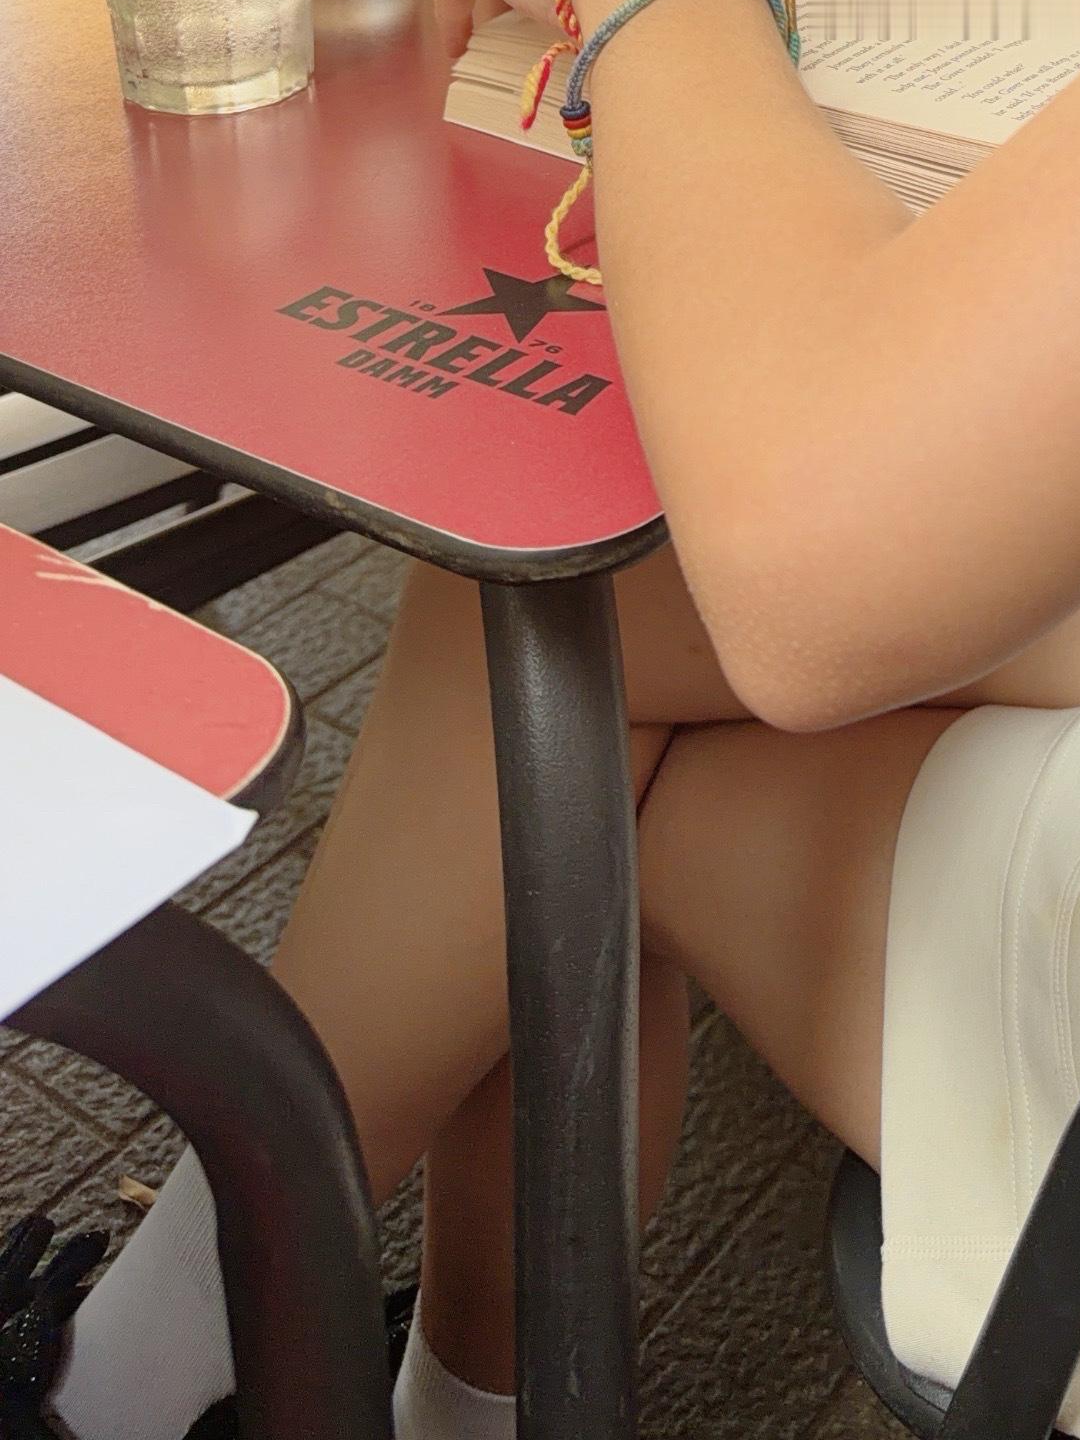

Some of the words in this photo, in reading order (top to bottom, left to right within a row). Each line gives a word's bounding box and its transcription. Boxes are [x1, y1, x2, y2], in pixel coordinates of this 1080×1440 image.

[409, 300, 437, 311] 18
[275, 286, 613, 416] ESTRELLA
[528, 339, 563, 354] 76
[335, 349, 460, 399] DAMM
